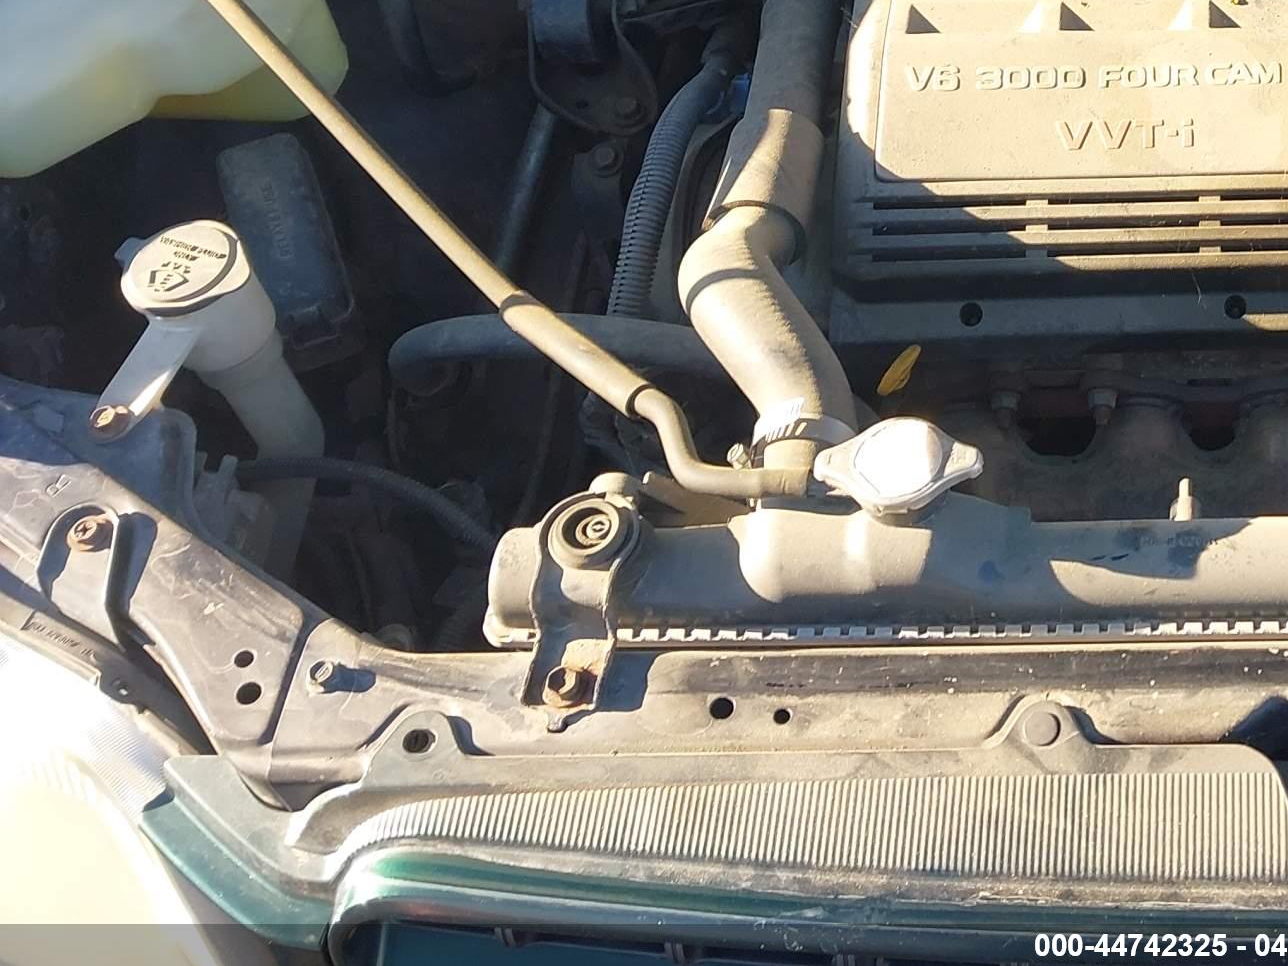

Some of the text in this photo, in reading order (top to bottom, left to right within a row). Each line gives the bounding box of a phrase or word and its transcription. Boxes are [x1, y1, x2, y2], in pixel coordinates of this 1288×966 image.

[904, 64, 961, 91] V6
[976, 65, 1087, 90] 3000
[1098, 64, 1200, 89] FOUR
[1204, 61, 1284, 85] CAM
[1054, 118, 1195, 151] VVT-i
